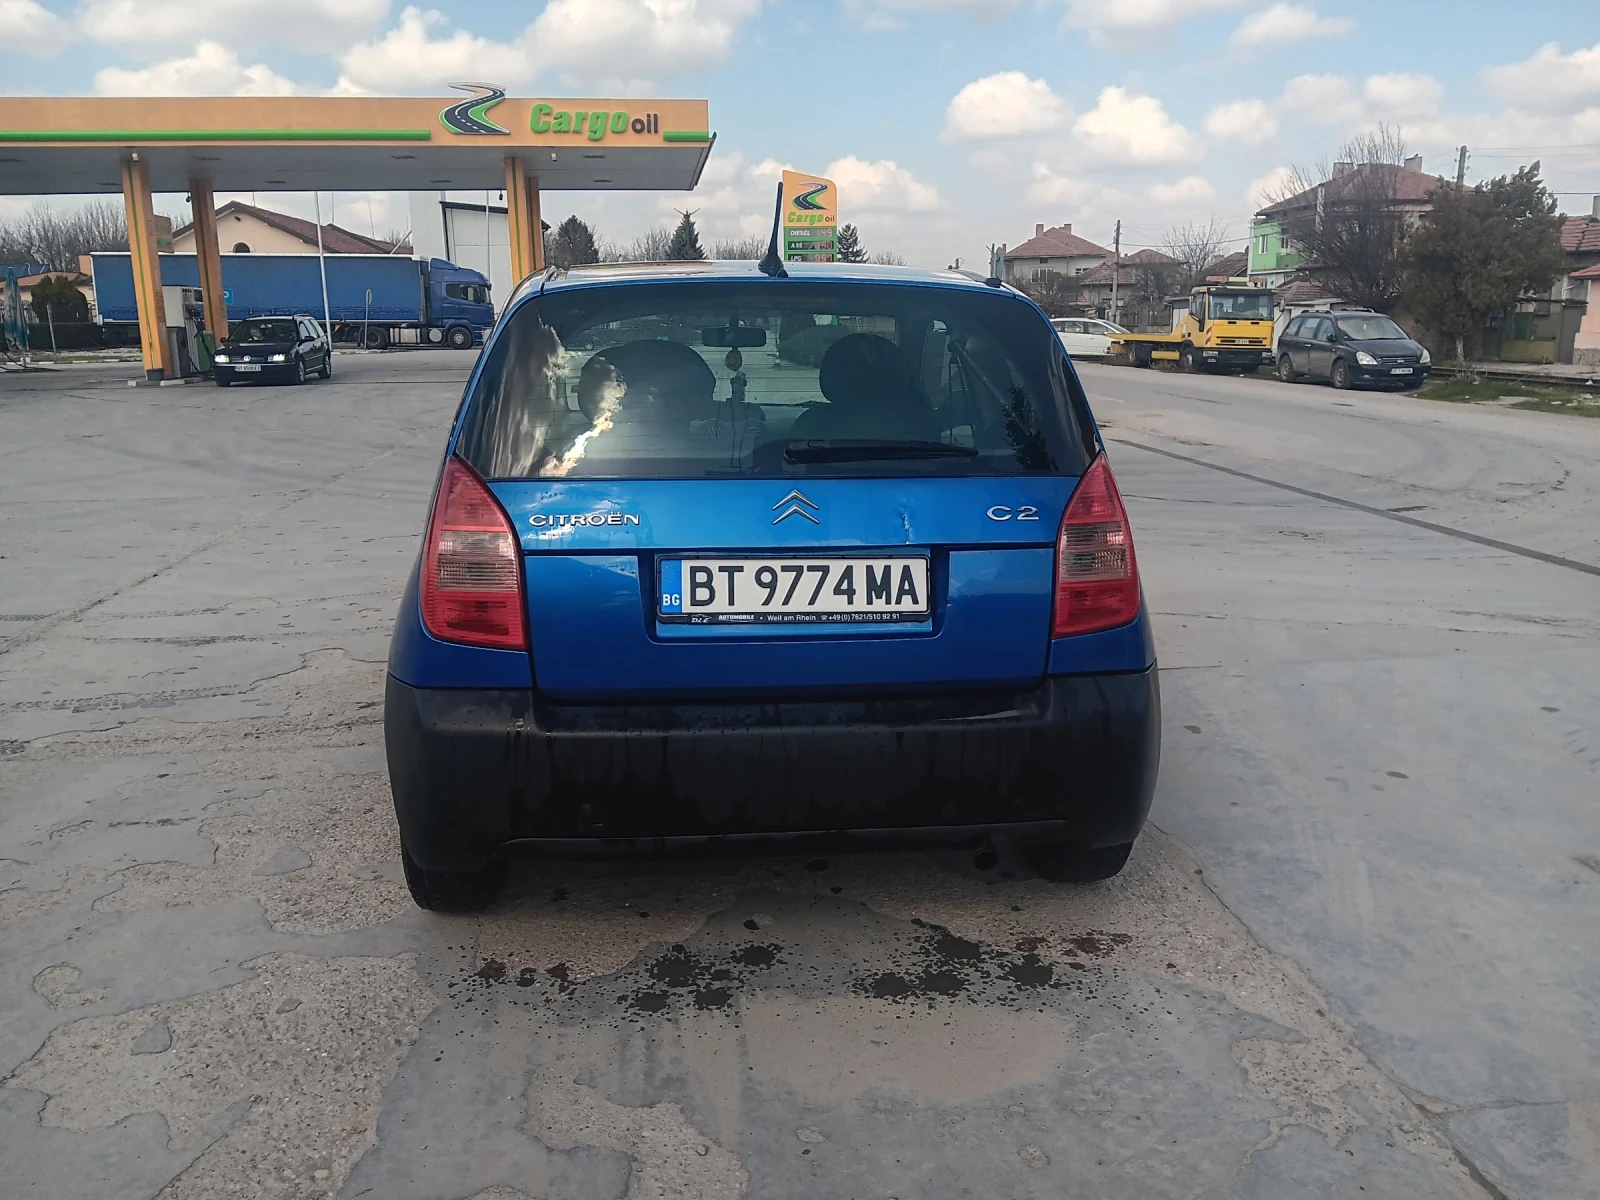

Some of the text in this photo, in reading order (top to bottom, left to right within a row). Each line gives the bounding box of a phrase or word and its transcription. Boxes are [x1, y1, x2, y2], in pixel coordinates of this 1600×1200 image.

[530, 103, 659, 141] Cargo oil
[788, 212, 824, 225] Cargo
[528, 510, 641, 527] CITROËN
[986, 505, 1040, 521] C2
[662, 564, 920, 607] BG BT 9774 MA
